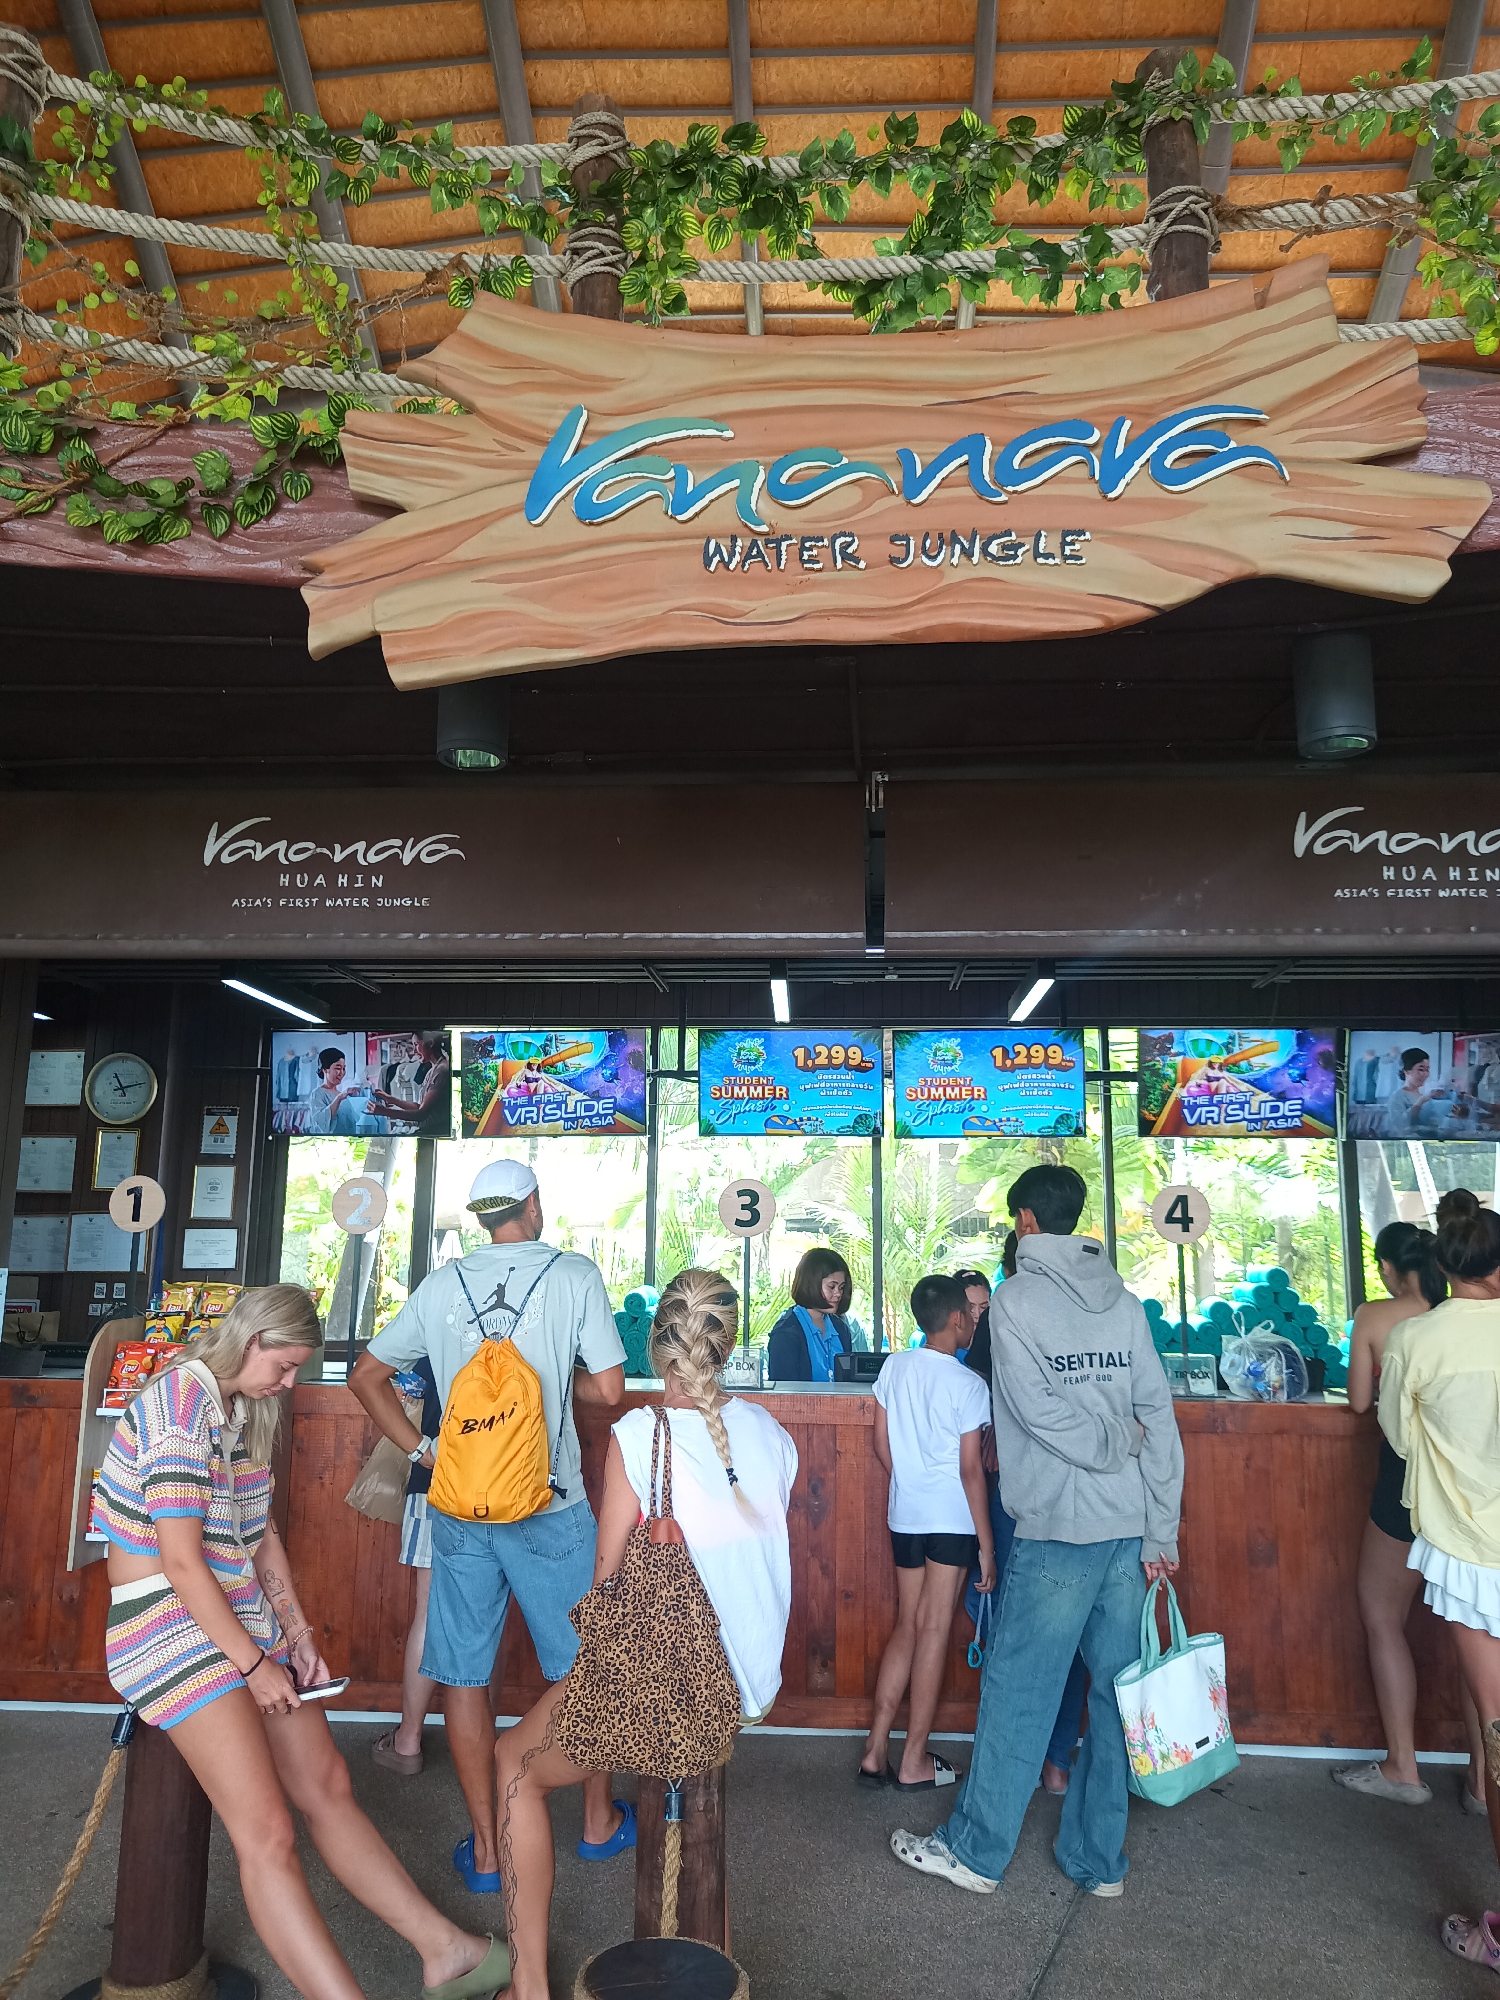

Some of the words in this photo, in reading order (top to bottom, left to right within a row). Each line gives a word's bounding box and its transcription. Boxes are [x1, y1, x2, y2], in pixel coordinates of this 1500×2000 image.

[702, 531, 867, 573] WATER
[889, 527, 1092, 568] JUNGLE
[279, 873, 327, 888] HUA
[337, 873, 384, 888] HIN
[1382, 865, 1437, 881] HUA
[1449, 866, 1500, 882] HIN
[1334, 887, 1380, 898] ASIA'S
[1386, 888, 1432, 898] FIRST
[1438, 888, 1488, 898] WATER
[231, 897, 273, 908] ASIA'S
[279, 897, 319, 908] FIRST
[325, 897, 370, 908] WATER
[376, 897, 431, 908] JUNGLE
[793, 1045, 863, 1068] 1,299
[991, 1044, 1063, 1068] 1,299
[723, 1076, 775, 1085] STUDENT
[918, 1077, 972, 1086] STUDENT
[503, 1096, 528, 1106] THE
[533, 1091, 570, 1104] FIRST
[710, 1085, 788, 1099] SUMMER
[906, 1086, 986, 1100] SUMMER
[1181, 1096, 1210, 1105] THE
[1213, 1091, 1254, 1103] FIRST
[503, 1106, 539, 1125] VR
[543, 1098, 615, 1121] SLIDE
[716, 1096, 777, 1125] Splash
[911, 1098, 975, 1126] Splash
[1182, 1106, 1219, 1125] VR
[1225, 1099, 1303, 1121] SLIDE
[564, 1121, 577, 1130] IN
[580, 1115, 615, 1127] ASIA
[1247, 1121, 1261, 1130] IN
[1265, 1117, 1302, 1129] ASIA
[126, 1185, 143, 1222] 1
[346, 1187, 372, 1226] 2
[734, 1188, 761, 1228] 3
[1164, 1194, 1194, 1234] 4
[735, 1361, 755, 1371] BOX
[1095, 1373, 1112, 1382] GOD
[1190, 1370, 1211, 1379] BOX
